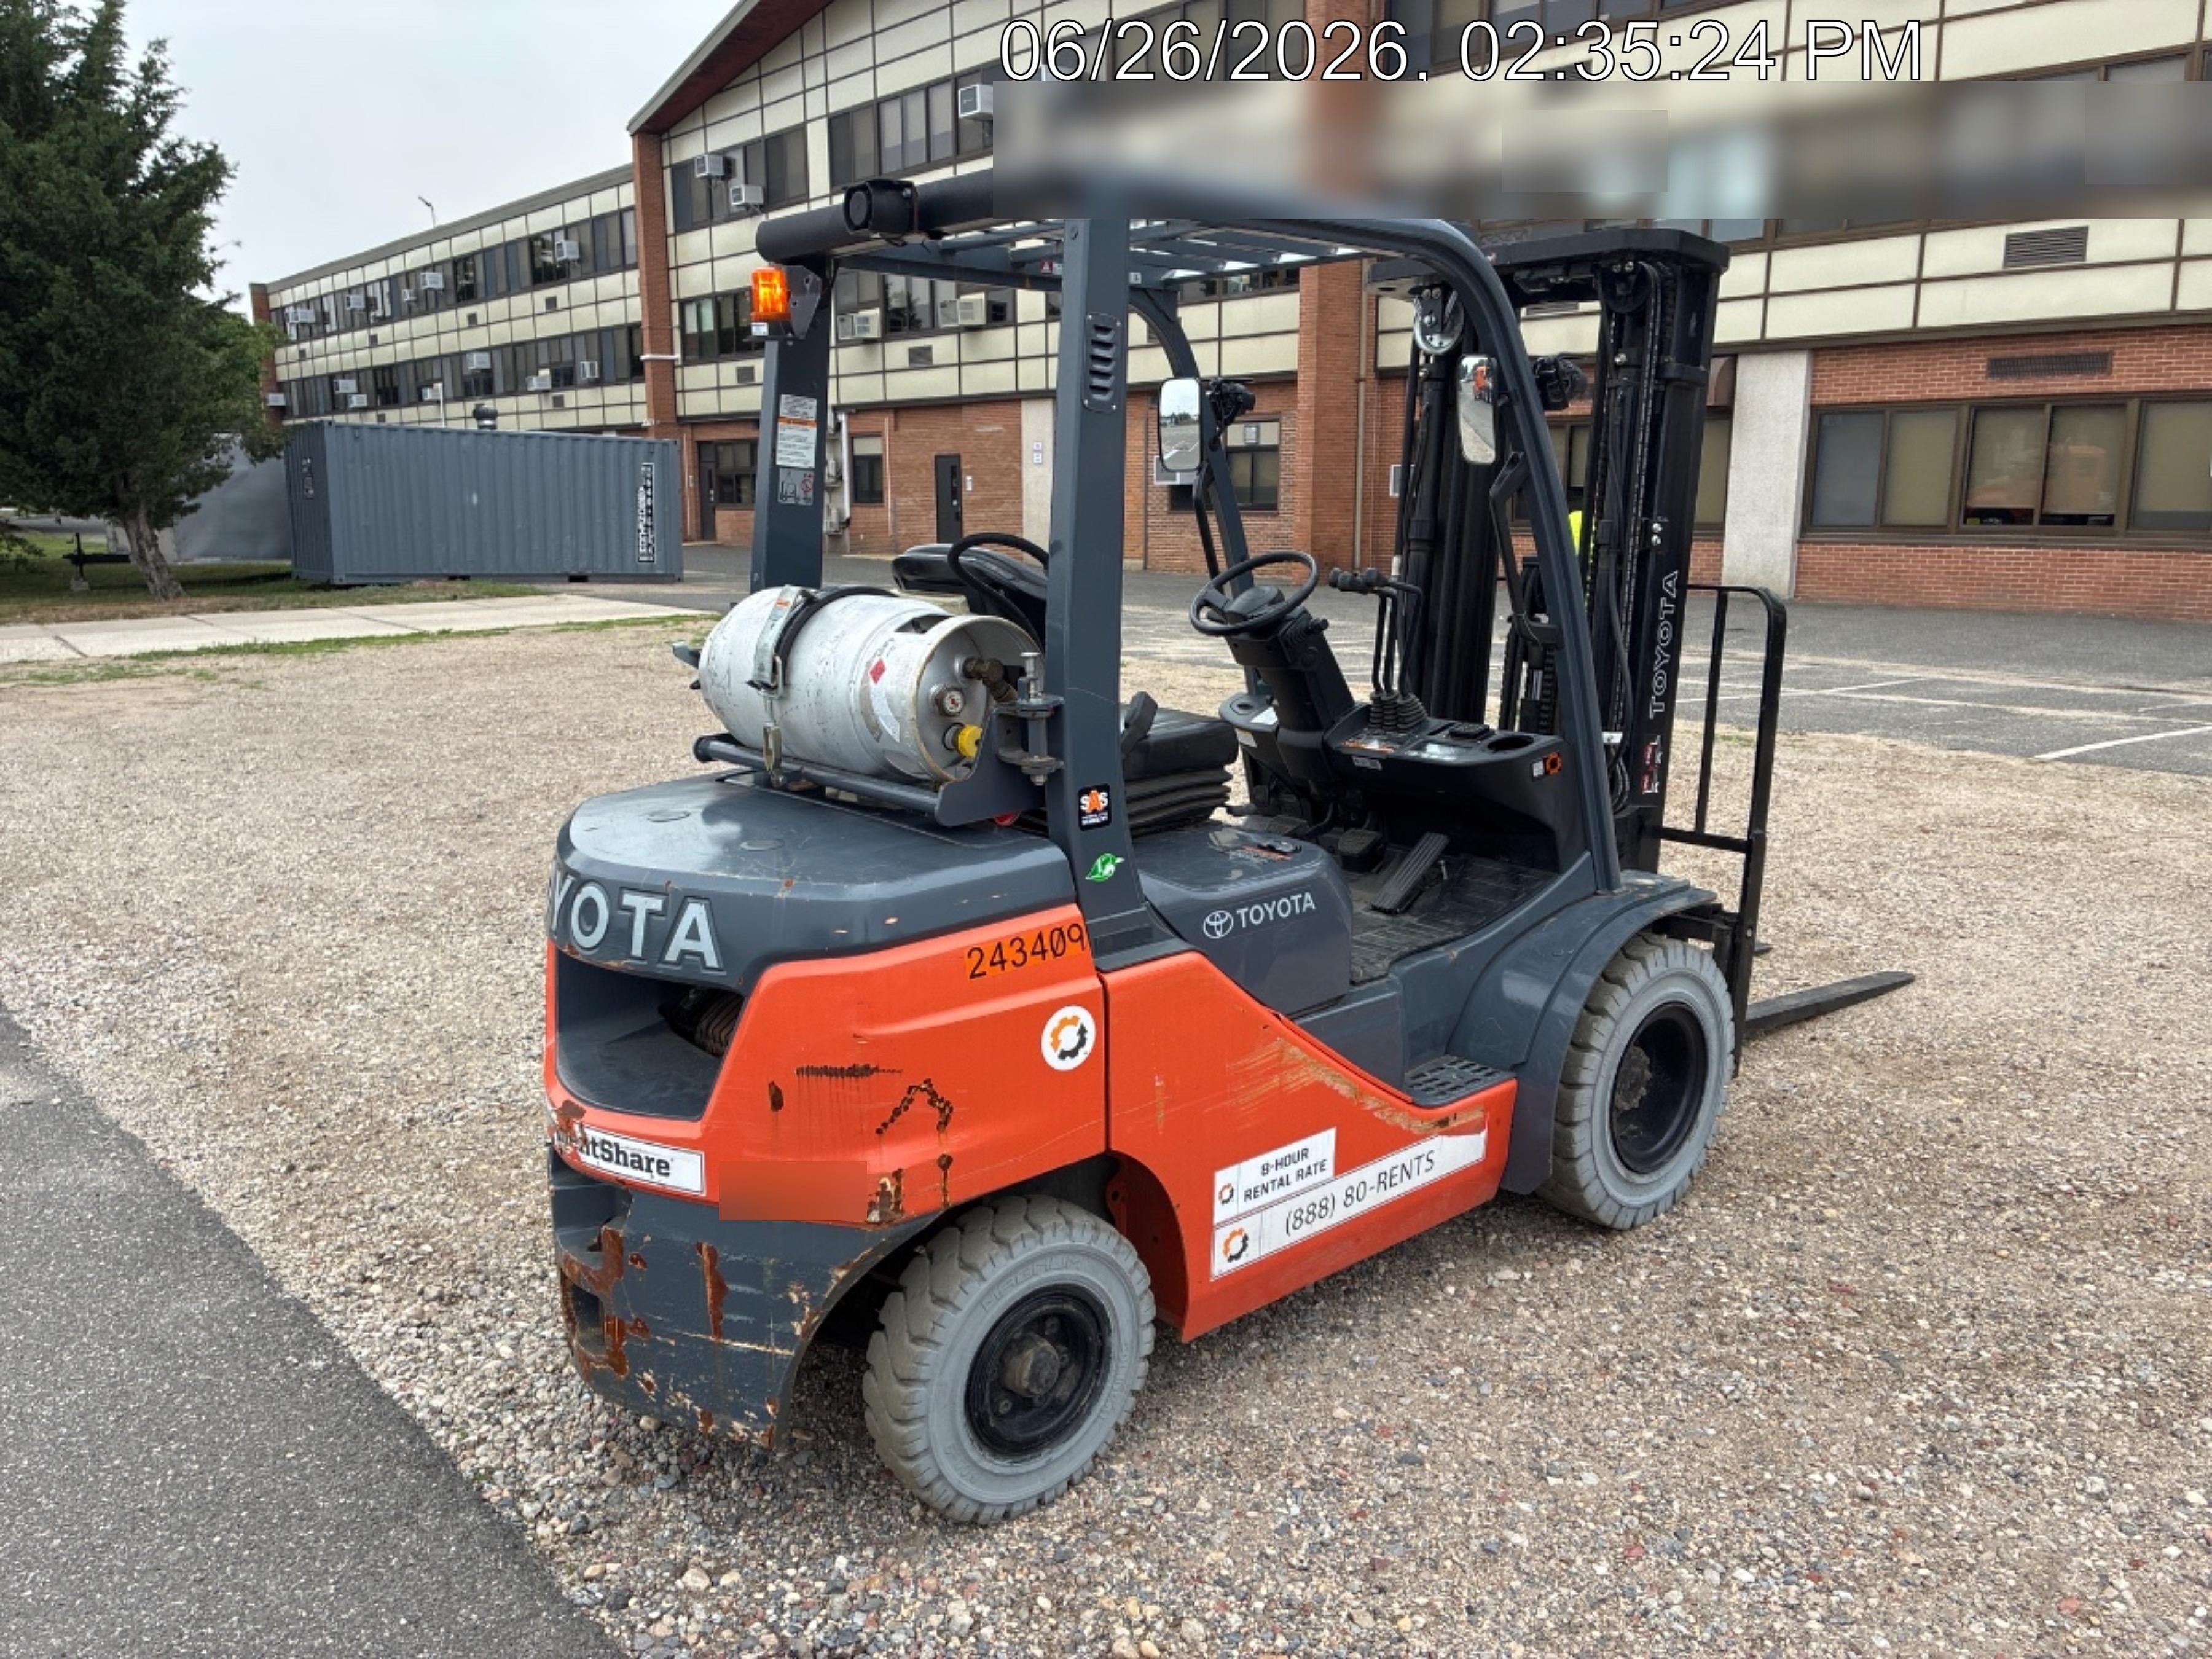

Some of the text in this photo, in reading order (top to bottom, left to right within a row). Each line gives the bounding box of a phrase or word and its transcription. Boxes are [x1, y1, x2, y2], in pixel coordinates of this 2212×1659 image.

[1649, 570, 1679, 720] TOYOTA
[1080, 790, 1109, 813] SAS
[1236, 892, 1316, 928] TOYOTA
[967, 923, 1085, 979] 243409
[1244, 1159, 1327, 1202] RENTAL RATE
[1261, 1148, 1309, 1176] 8-HOUR
[1285, 1150, 1435, 1236] (888) 80-RENTS
